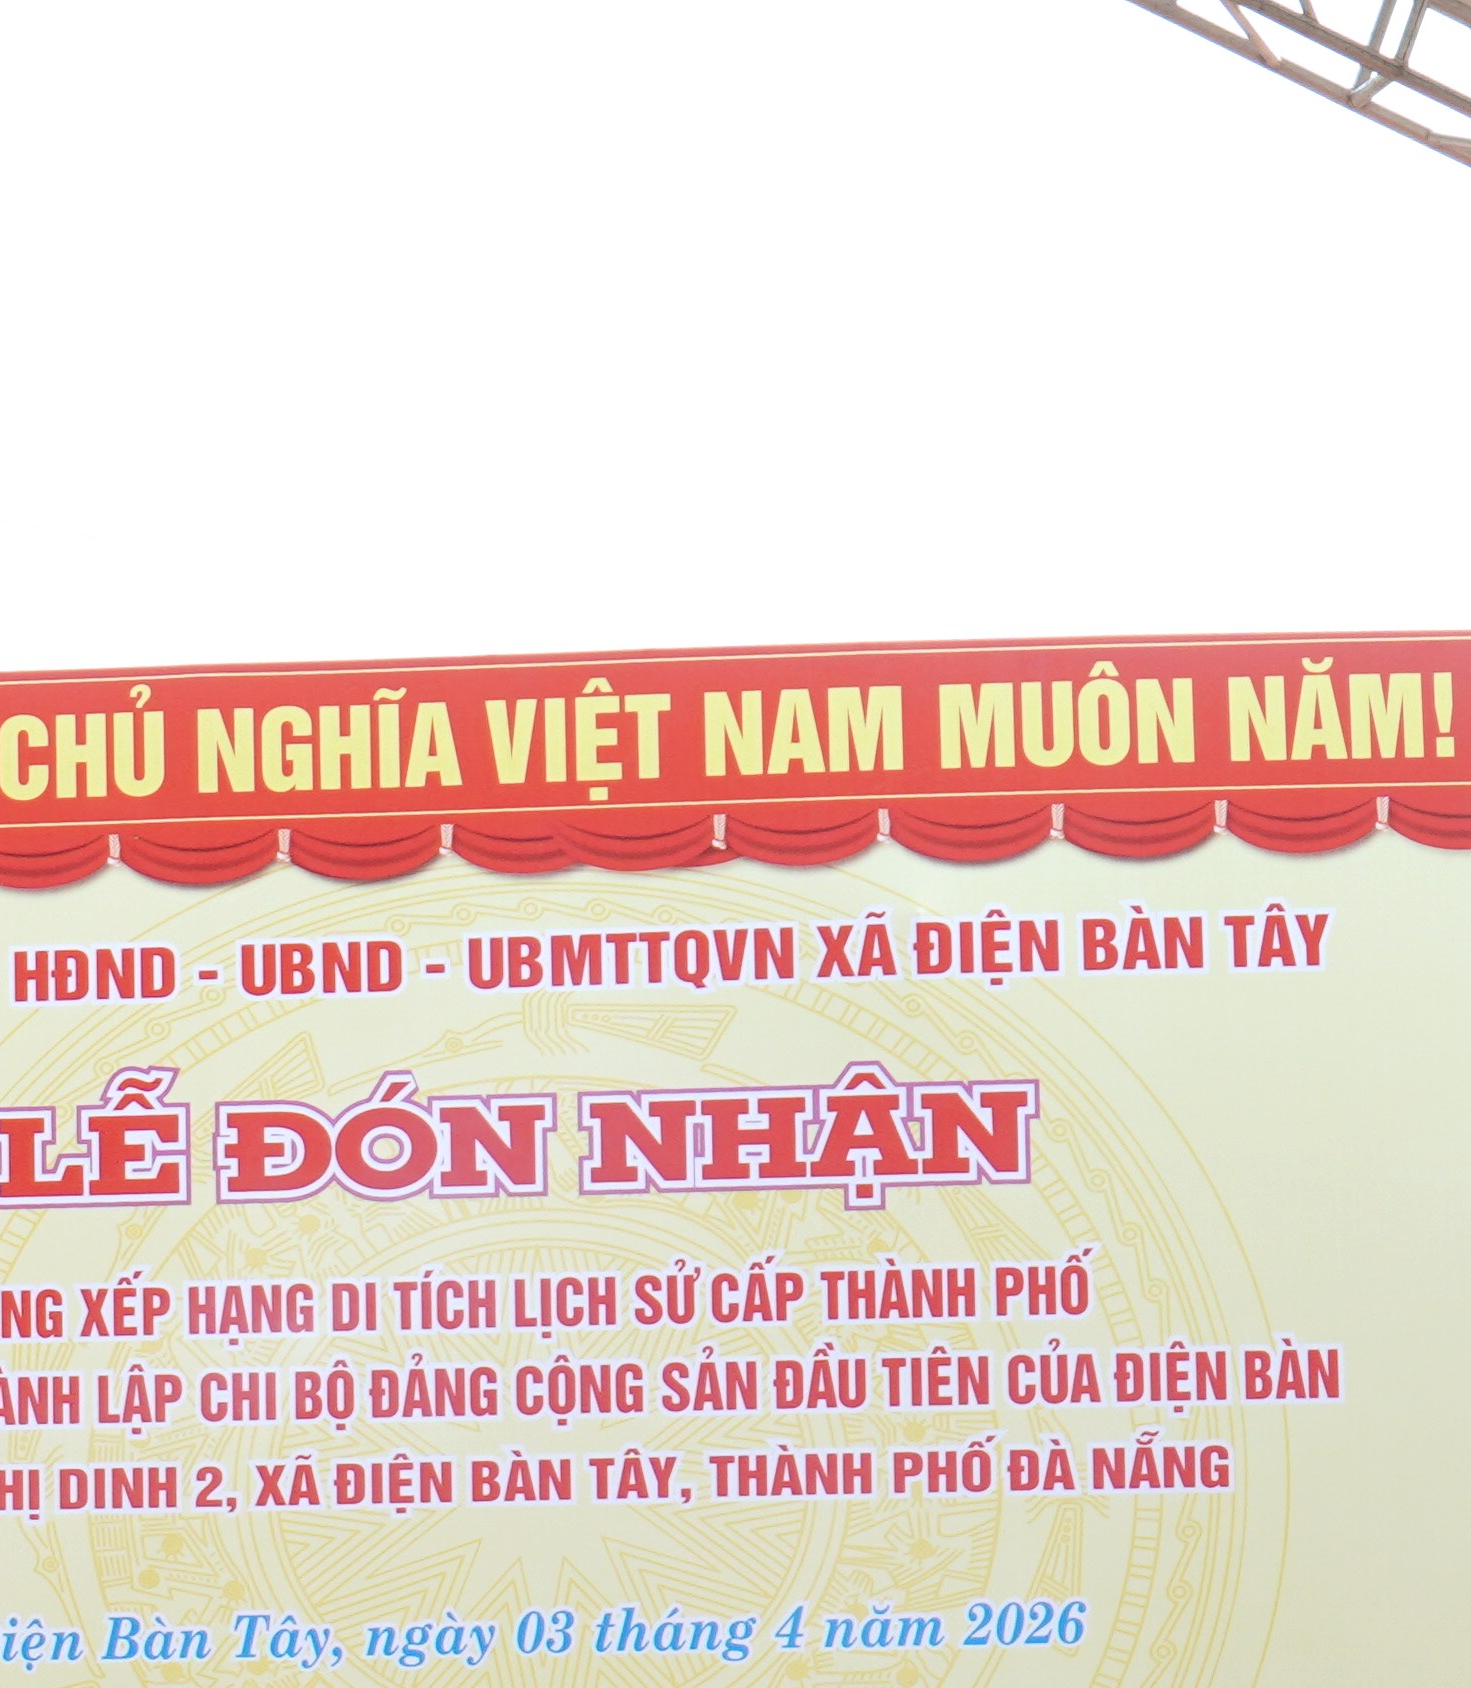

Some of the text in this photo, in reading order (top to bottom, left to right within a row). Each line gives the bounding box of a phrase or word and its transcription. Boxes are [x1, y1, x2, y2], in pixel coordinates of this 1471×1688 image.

[197, 687, 462, 793] NGHĨA
[485, 678, 671, 801] VIỆT
[704, 686, 903, 776] NAM
[939, 661, 1195, 769] MUÔN
[1228, 657, 1455, 761] NĂM!
[14, 948, 175, 1001] HĐND
[199, 970, 218, 979] -
[242, 941, 402, 995] UBND
[427, 964, 445, 972] -
[469, 928, 794, 988] UBMTTQVN
[818, 912, 896, 976] XÃ
[914, 910, 1059, 984] ĐIỆN
[1083, 906, 1203, 970] BÀN
[1225, 904, 1328, 966] TÂY
[225, 1082, 545, 1191] ĐÓN
[591, 1073, 1028, 1198] NHẬN
[82, 1272, 170, 1336] XẾP
[190, 1284, 313, 1343] HẠNG
[333, 1284, 376, 1330] DI
[395, 1272, 496, 1328] TÍCH
[516, 1277, 616, 1338] LỊCH
[636, 1260, 700, 1324] SỬ
[712, 1256, 804, 1322] CẤP
[821, 1259, 975, 1319] THÀNH
[996, 1249, 1090, 1315] PHỐ
[99, 1364, 182, 1433] LẬP
[202, 1373, 276, 1421] CHI
[297, 1361, 354, 1429] BỘ
[370, 1355, 497, 1417] ĐẢNG
[517, 1356, 643, 1424] CỘNG
[663, 1347, 757, 1411] SẢN
[775, 1344, 866, 1408] ĐẦU
[882, 1346, 989, 1406] TIÊN
[1009, 1339, 1100, 1404] CỦA
[1115, 1341, 1226, 1412] ĐIỆN
[1245, 1339, 1339, 1398] BÀN
[60, 1468, 177, 1508] DINH
[197, 1467, 236, 1513] 2,
[257, 1456, 320, 1505] XÃ
[335, 1454, 452, 1513] ĐIỆN
[473, 1448, 571, 1501] BÀN
[590, 1449, 691, 1503] TÂY,
[711, 1445, 872, 1496] THÀNH
[894, 1437, 994, 1492] PHỐ
[1009, 1440, 1074, 1490] ĐÀ
[1094, 1432, 1229, 1488] NẴNG
[100, 1616, 210, 1661] Bàn
[233, 1615, 343, 1669] Tây,
[365, 1611, 496, 1668] ngày
[515, 1610, 575, 1655] 03
[594, 1607, 757, 1662] tháng
[773, 1606, 804, 1650] 4
[823, 1605, 944, 1649] năm
[962, 1601, 1087, 1647] 2026
